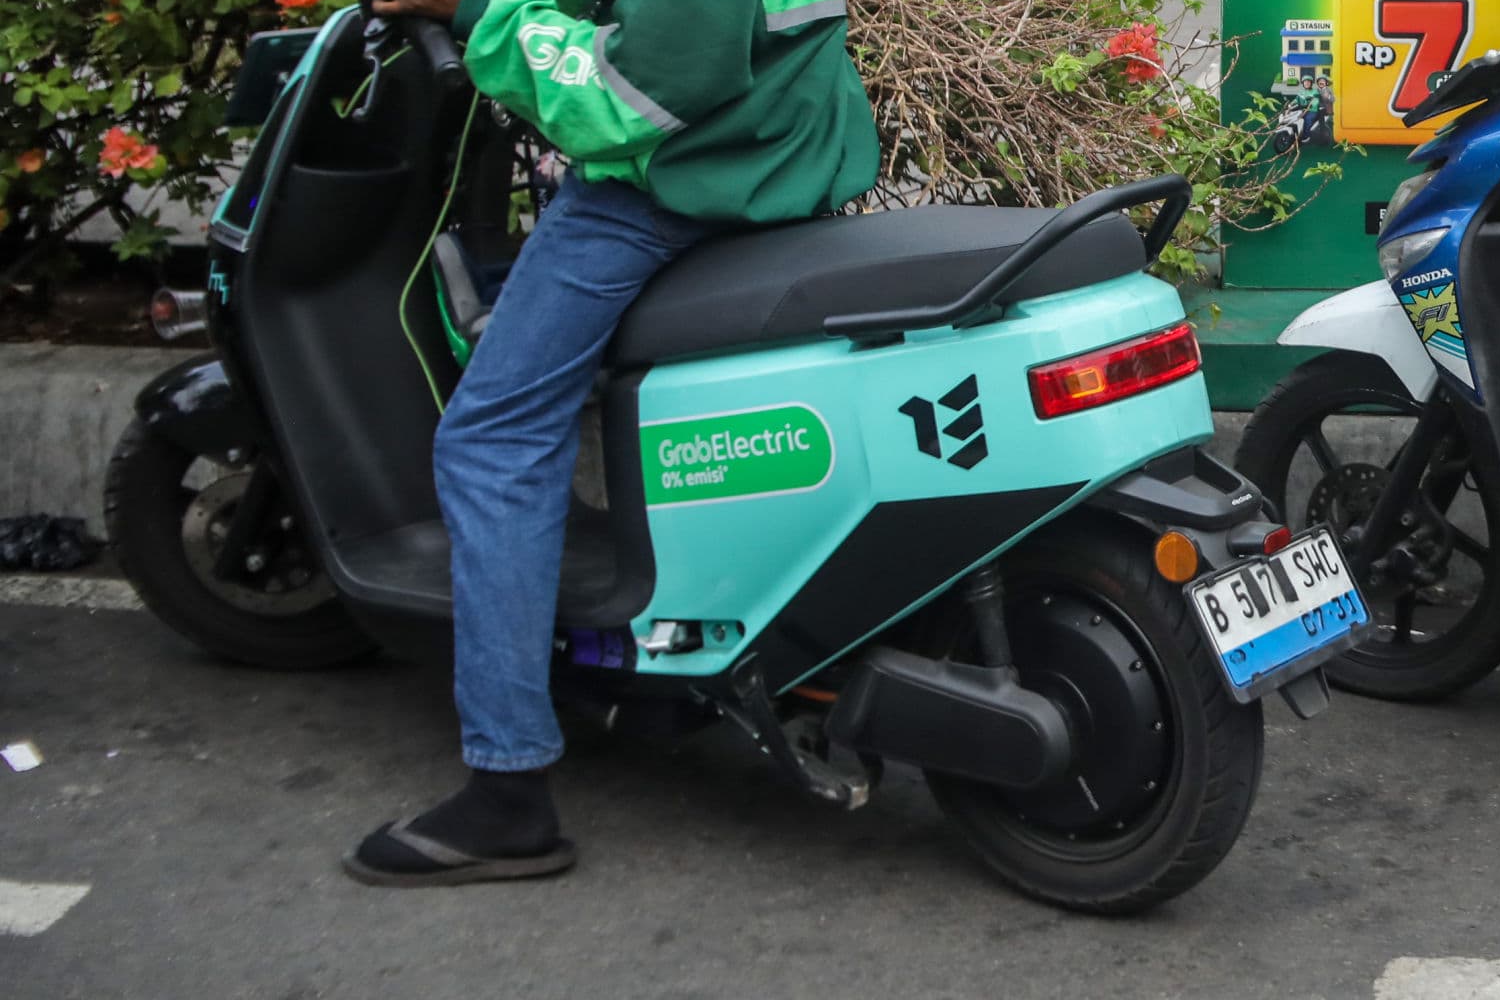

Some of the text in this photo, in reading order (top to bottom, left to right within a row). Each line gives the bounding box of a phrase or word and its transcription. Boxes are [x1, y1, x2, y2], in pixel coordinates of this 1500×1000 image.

[1354, 42, 1396, 68] Rp
[1402, 267, 1454, 289] HONDA
[1415, 302, 1452, 328] FI
[657, 422, 811, 468] GrabElectric
[661, 470, 684, 489] 0%
[1203, 593, 1230, 634] B
[1292, 539, 1340, 589] SWC
